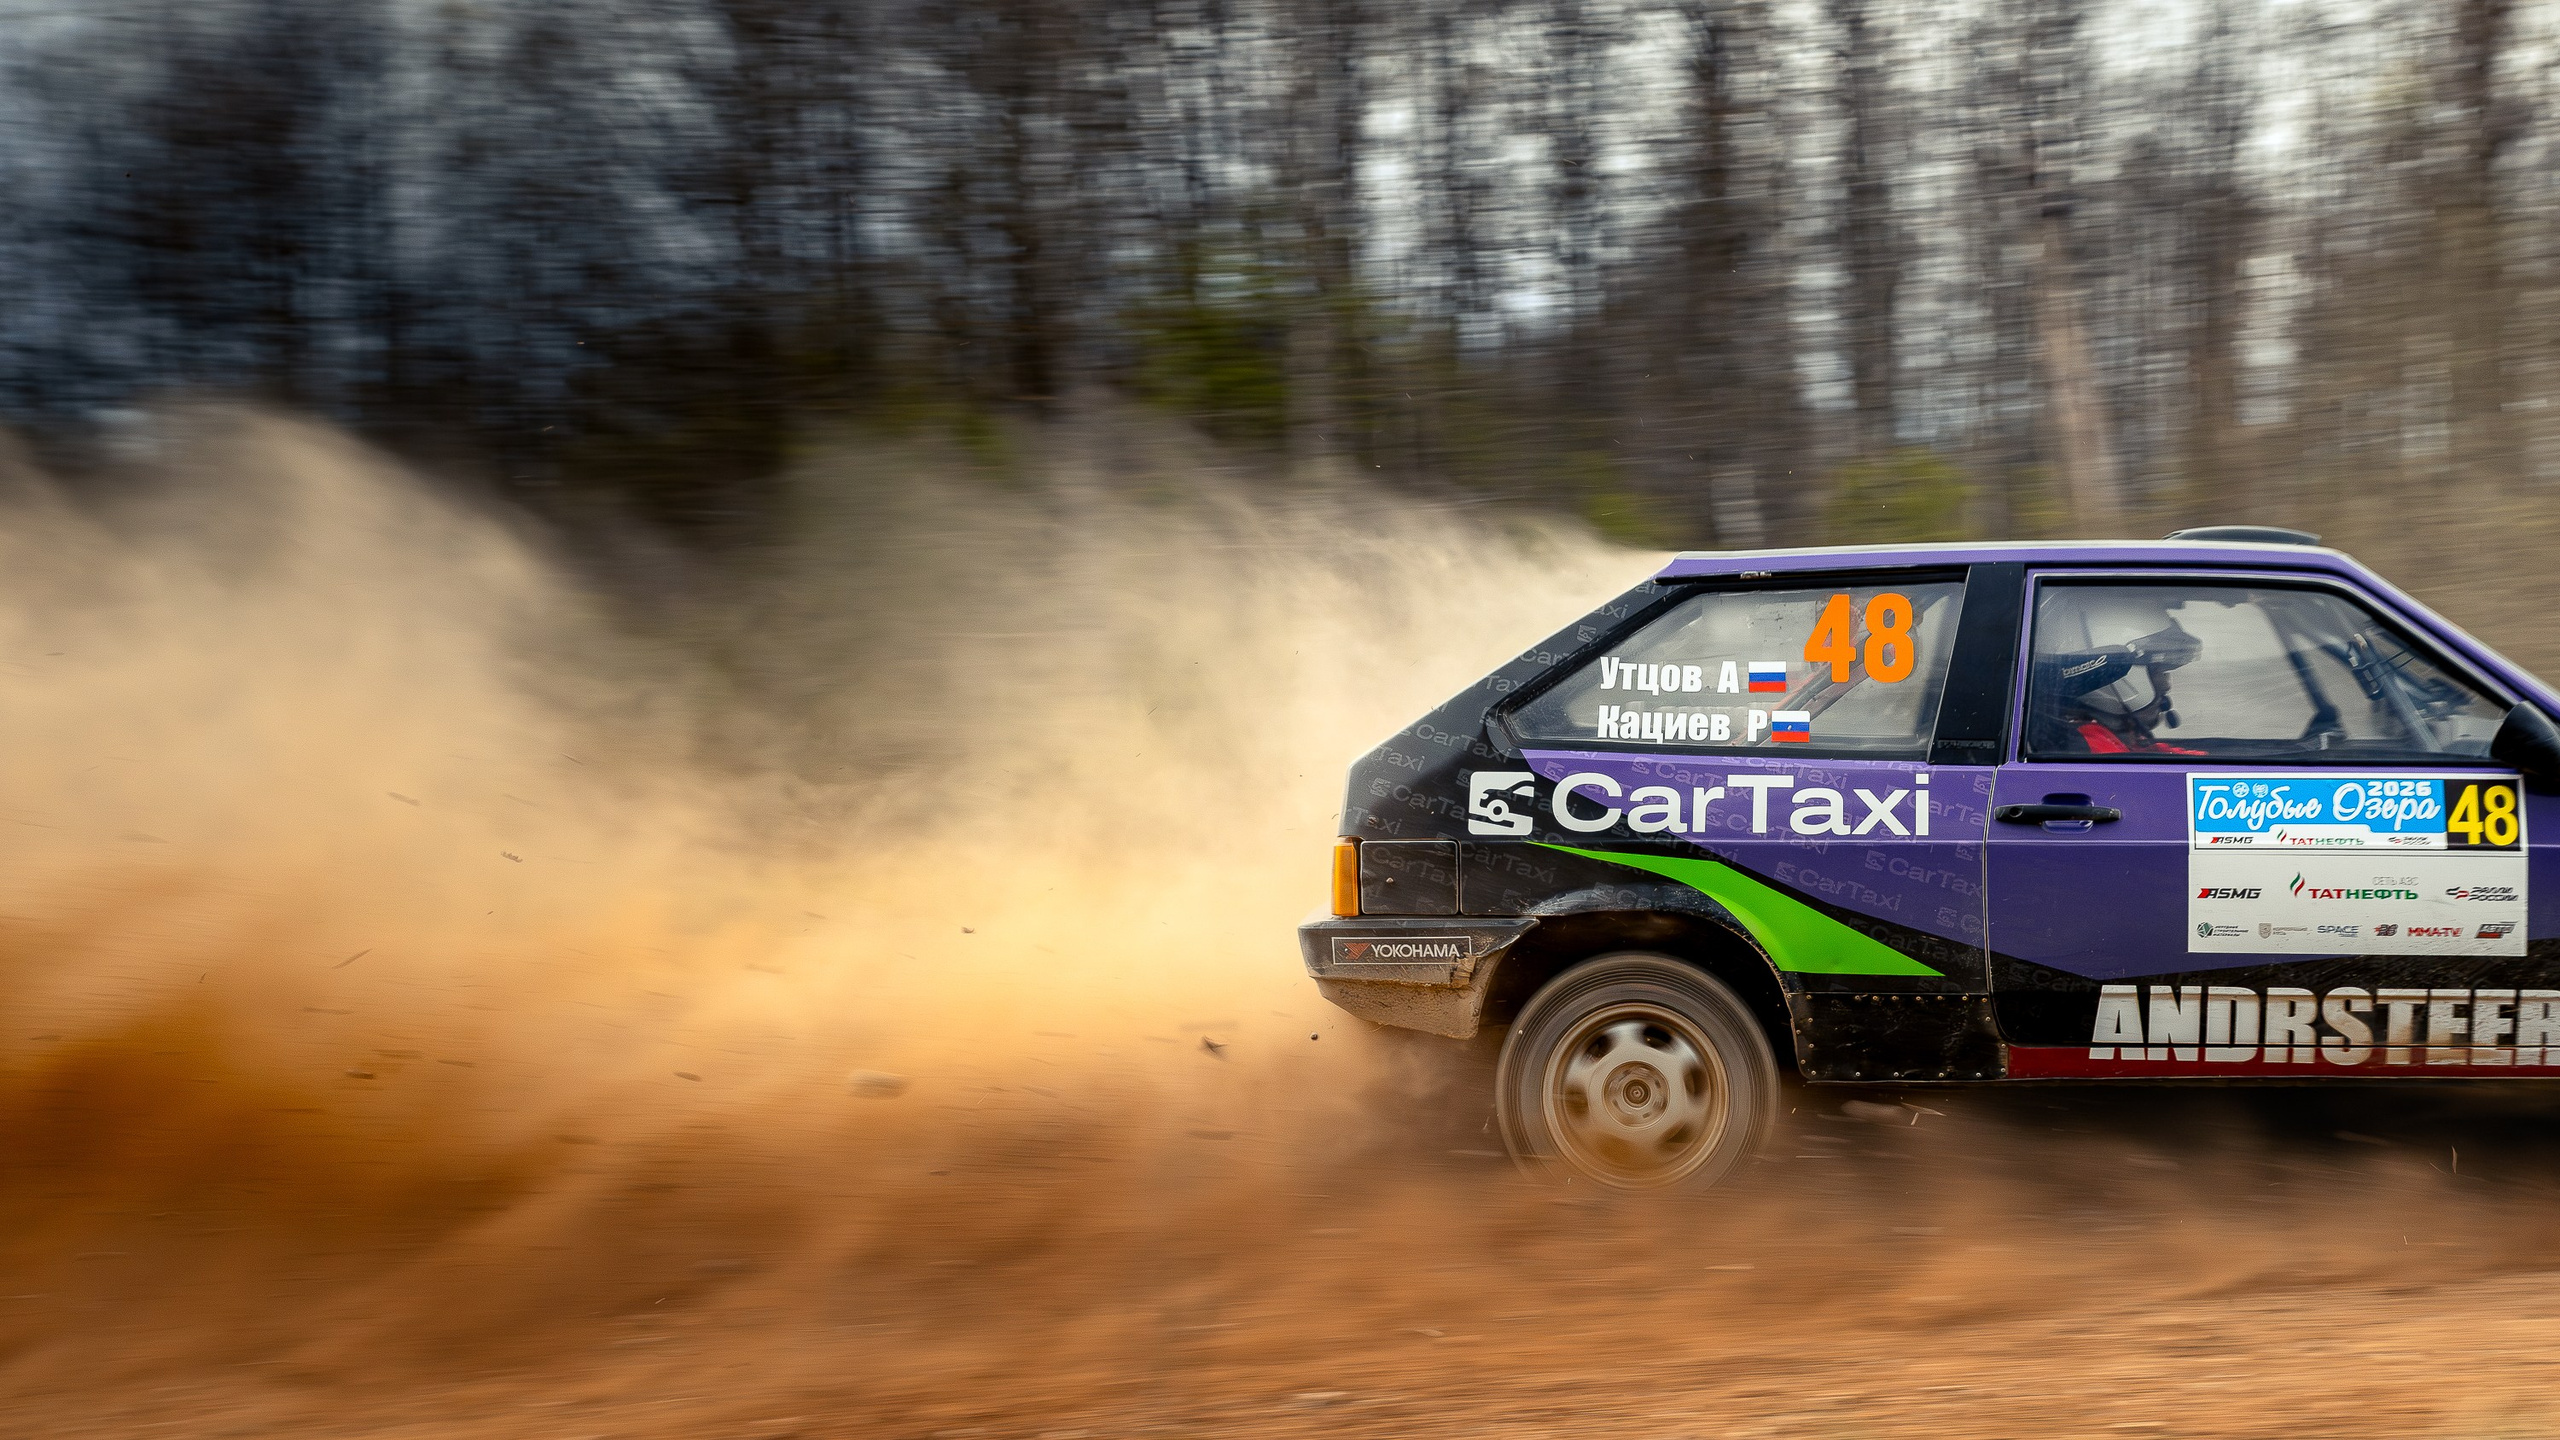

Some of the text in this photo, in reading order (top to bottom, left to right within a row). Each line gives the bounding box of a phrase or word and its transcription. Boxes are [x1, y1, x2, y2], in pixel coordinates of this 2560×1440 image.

[1804, 592, 1915, 684] 48
[1599, 656, 1702, 696] Утцов
[1597, 705, 1731, 744] Кациев
[1551, 771, 1929, 836] CarTaxi
[2367, 780, 2432, 797] 2026
[2447, 784, 2519, 846] 48
[1888, 857, 1983, 898] CarTax
[2308, 888, 2419, 900] ТАТНЕФТЬ
[2317, 925, 2359, 934] SPACE
[1371, 943, 1460, 959] YOKOHAMA
